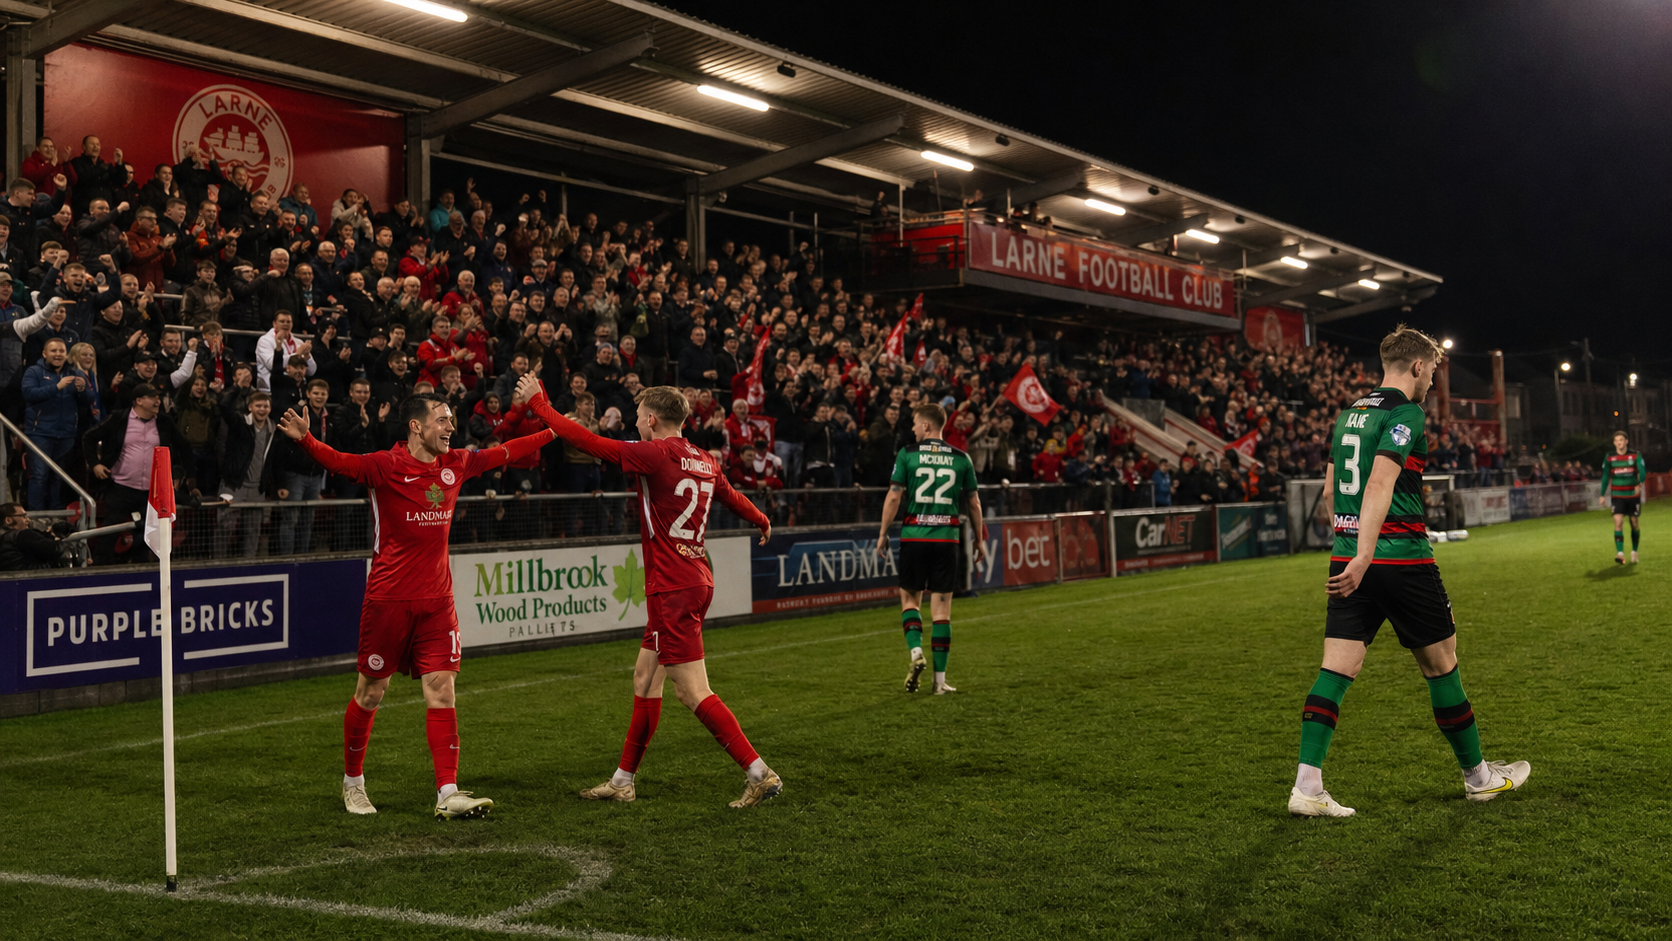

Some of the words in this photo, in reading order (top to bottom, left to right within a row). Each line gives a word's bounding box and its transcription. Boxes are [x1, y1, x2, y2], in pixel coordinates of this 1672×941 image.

[198, 93, 272, 131] LARNE
[991, 231, 1066, 280] LARNE
[1078, 251, 1174, 301] FOOTBALL
[1182, 274, 1223, 309] CLUB
[1339, 433, 1361, 496] 3
[915, 467, 956, 505] 22
[669, 478, 714, 543] 27
[1135, 514, 1196, 548] CarNET
[1007, 529, 1050, 570] bet
[474, 554, 608, 597] Millbrook
[47, 609, 163, 647] PURPLE
[180, 598, 274, 634] BRICKS
[475, 598, 527, 625] Wood
[533, 594, 607, 619] Products
